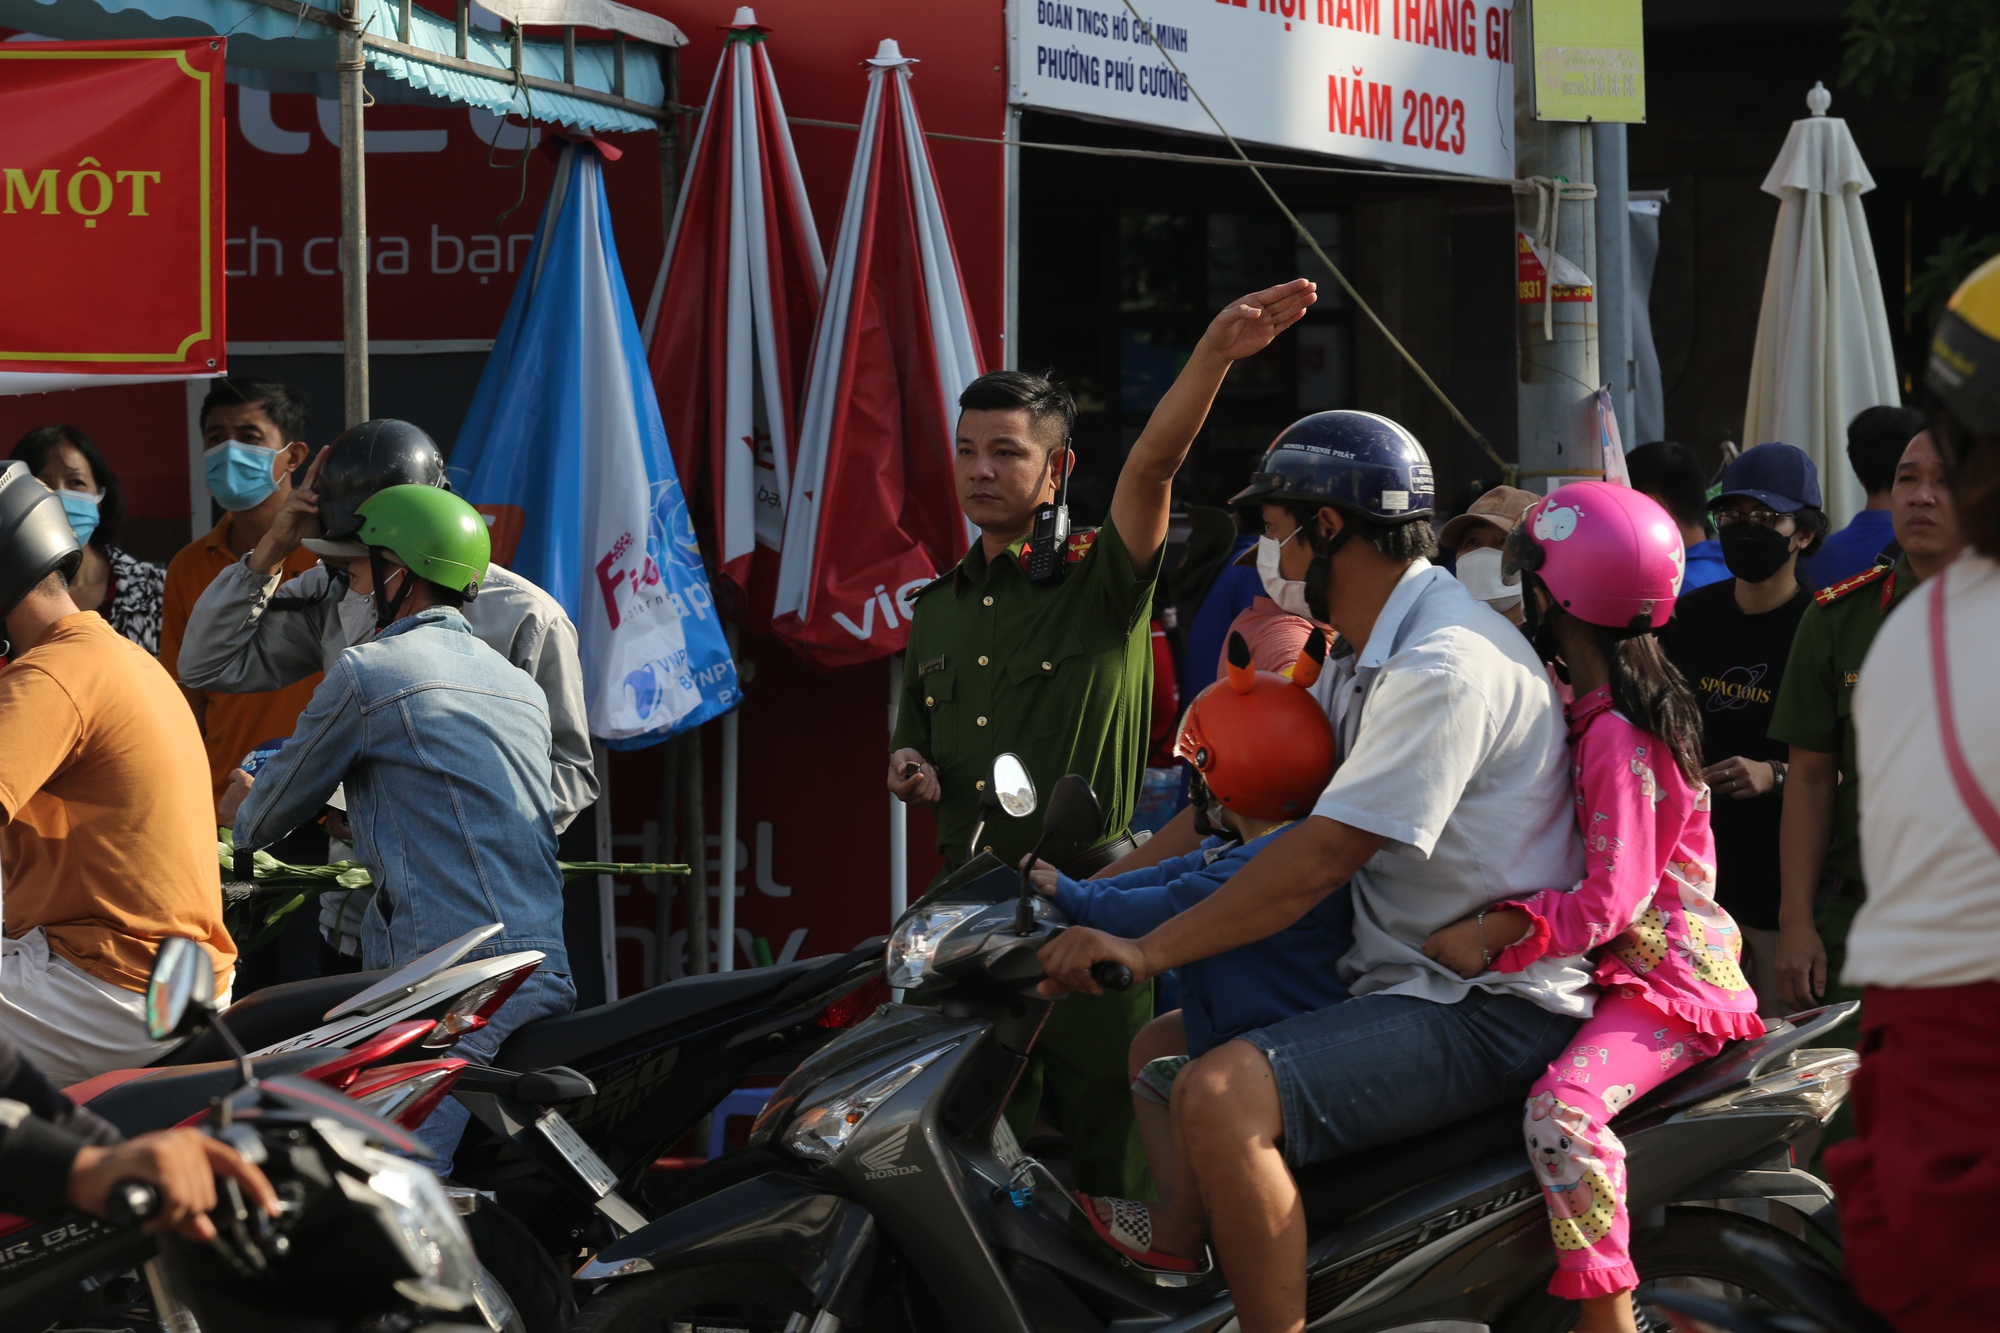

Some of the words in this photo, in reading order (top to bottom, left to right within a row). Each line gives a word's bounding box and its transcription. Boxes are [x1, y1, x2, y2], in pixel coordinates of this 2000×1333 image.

[1076, 8, 1109, 38] TNCS
[1156, 23, 1188, 52] MINH
[1485, 6, 1514, 65] GI
[1037, 45, 1100, 87] PHƯỜNG
[1104, 56, 1134, 93] PHÚ
[1139, 61, 1189, 102] CƯỜNG
[1327, 65, 1393, 143] NĂM
[1402, 89, 1466, 156] 2023
[2, 156, 161, 228] MỘT
[1699, 676, 1771, 704] SPACIOUS
[864, 1165, 923, 1180] HONDA
[41, 1219, 100, 1246] BL
